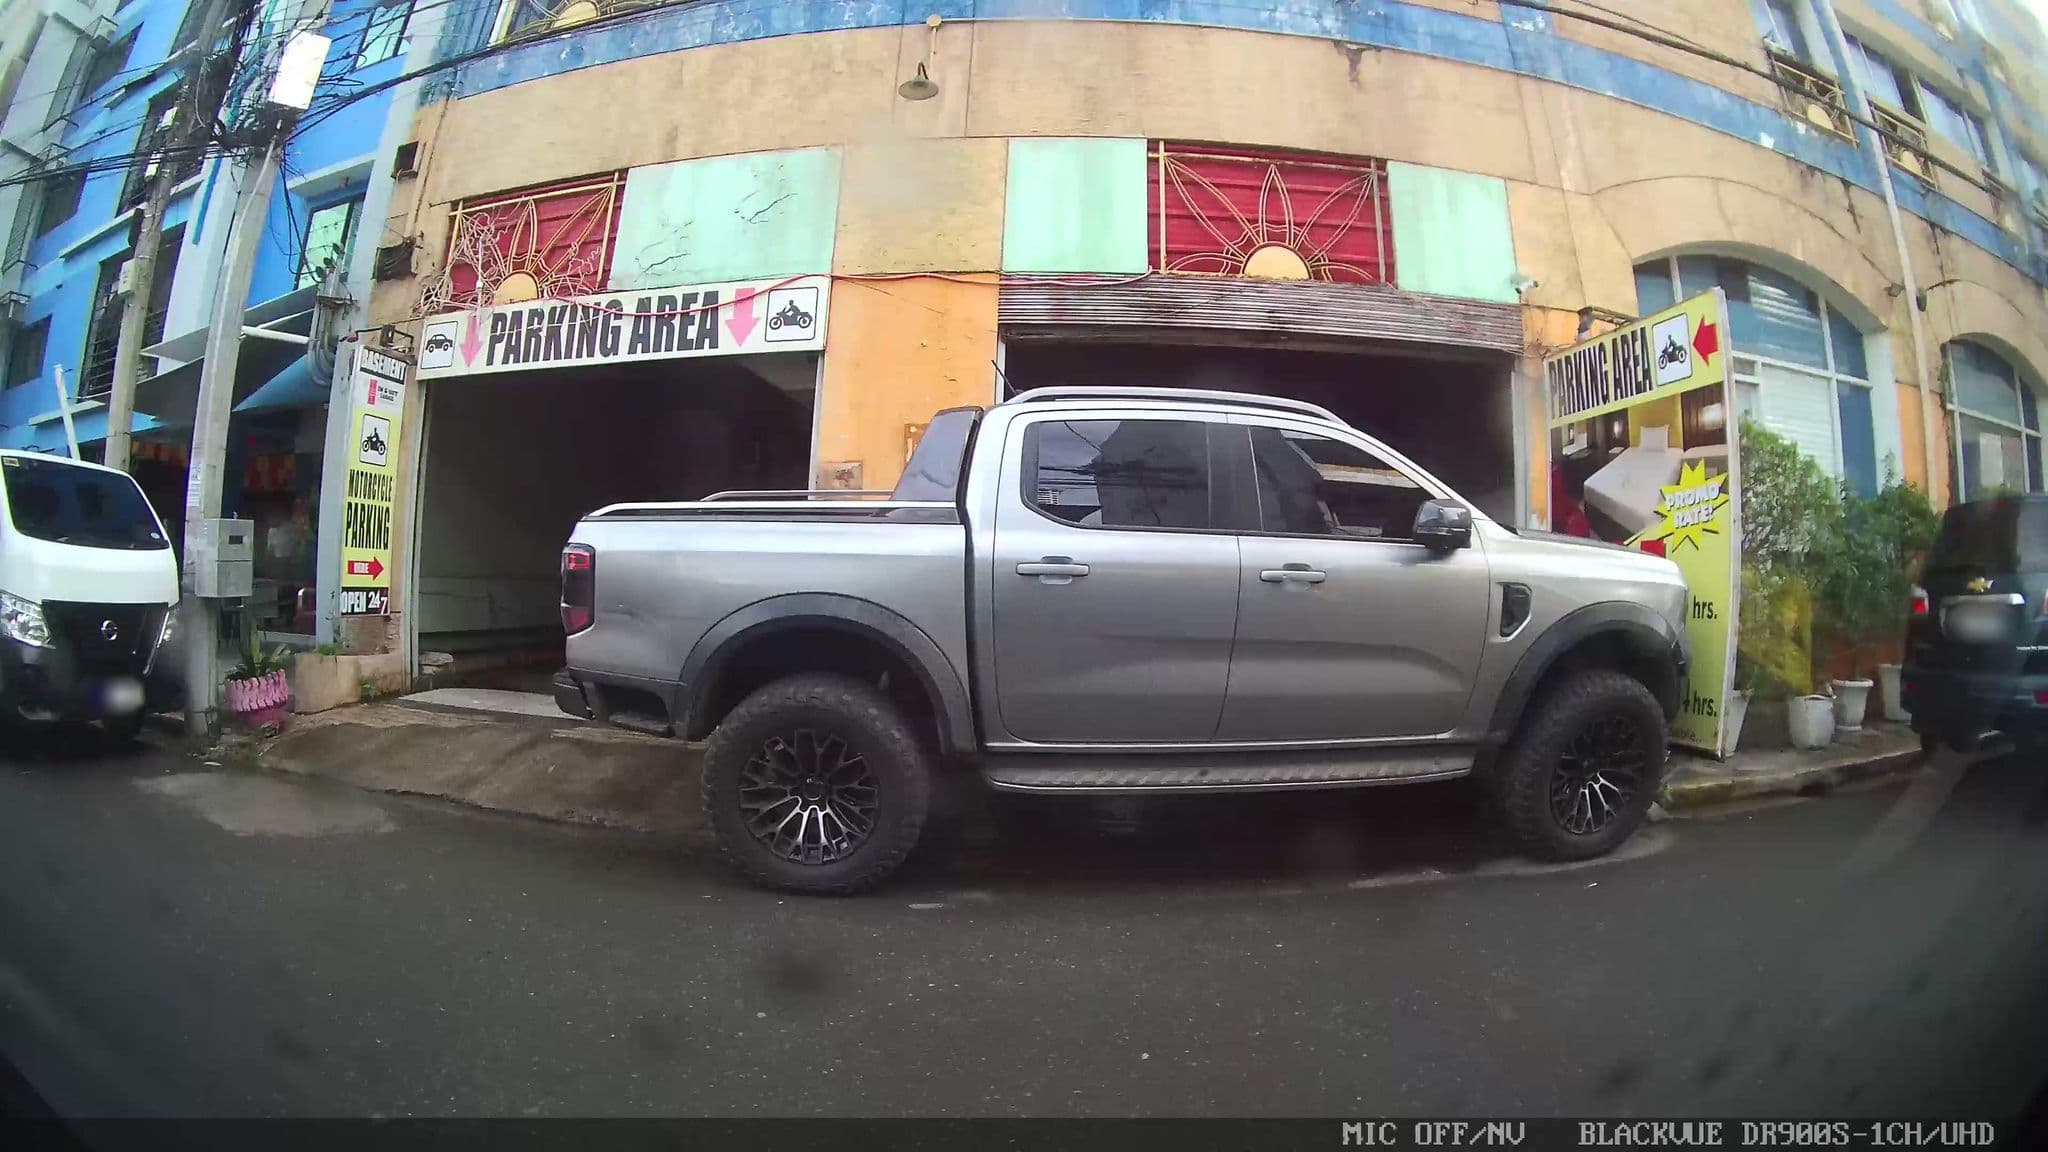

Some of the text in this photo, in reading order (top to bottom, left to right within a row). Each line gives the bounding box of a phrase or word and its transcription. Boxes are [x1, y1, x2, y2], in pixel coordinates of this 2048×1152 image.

[486, 290, 720, 366] PARKING AREA
[360, 348, 407, 381] BASEMENT
[1548, 326, 1653, 420] PARKING AREA
[348, 469, 393, 502] MOTORCYCLE
[1665, 483, 1721, 512] PROMO
[345, 502, 390, 550] PARKING
[341, 591, 367, 614] OPEN
[1692, 595, 1718, 619] hrs.
[1692, 690, 1717, 718] hrs.
